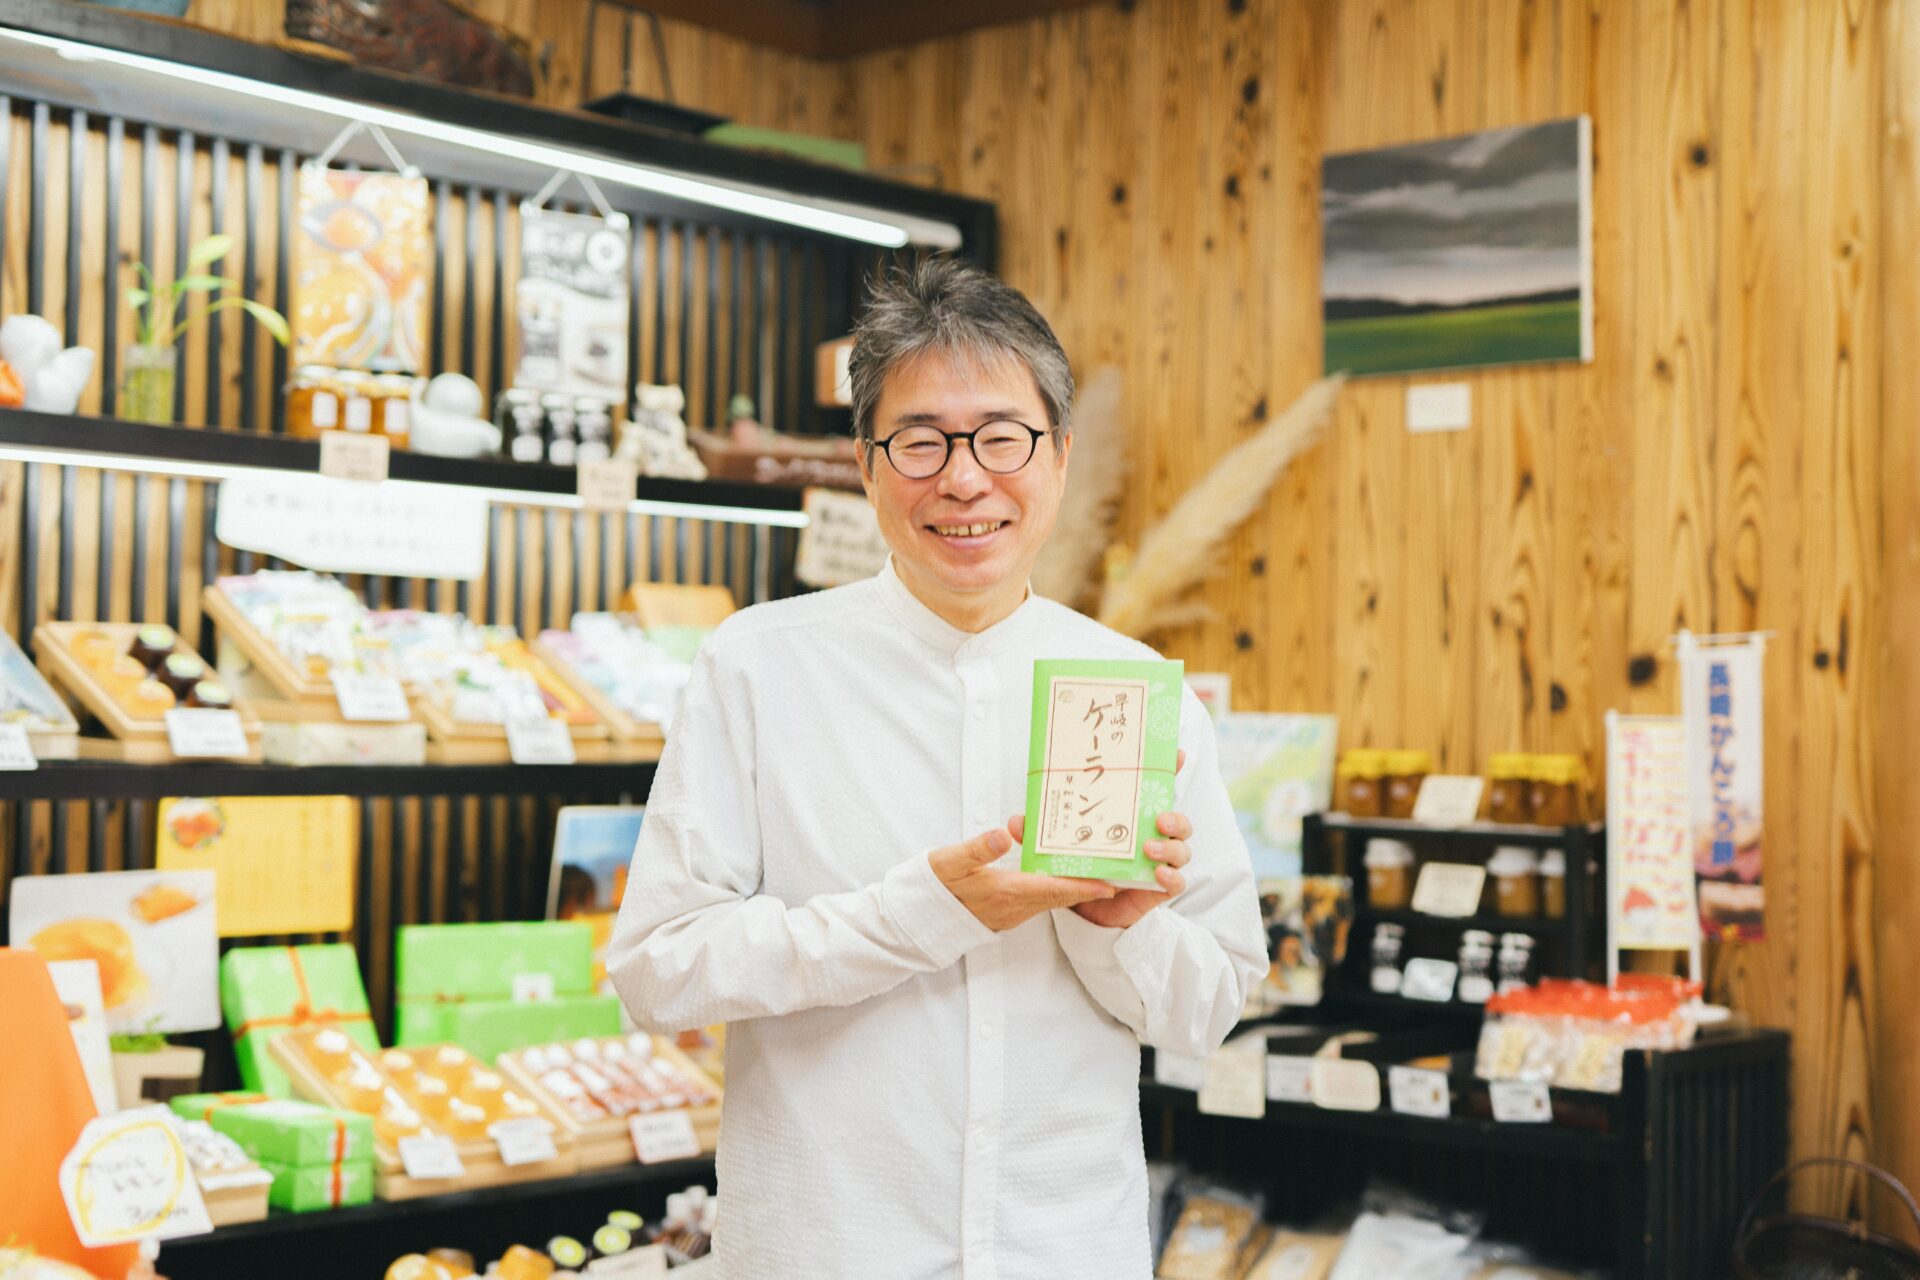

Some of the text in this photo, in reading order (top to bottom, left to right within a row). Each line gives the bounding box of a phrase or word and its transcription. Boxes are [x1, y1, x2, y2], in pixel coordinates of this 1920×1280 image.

[1078, 698, 1112, 816] ケーラン
[1110, 692, 1129, 745] 早岐の
